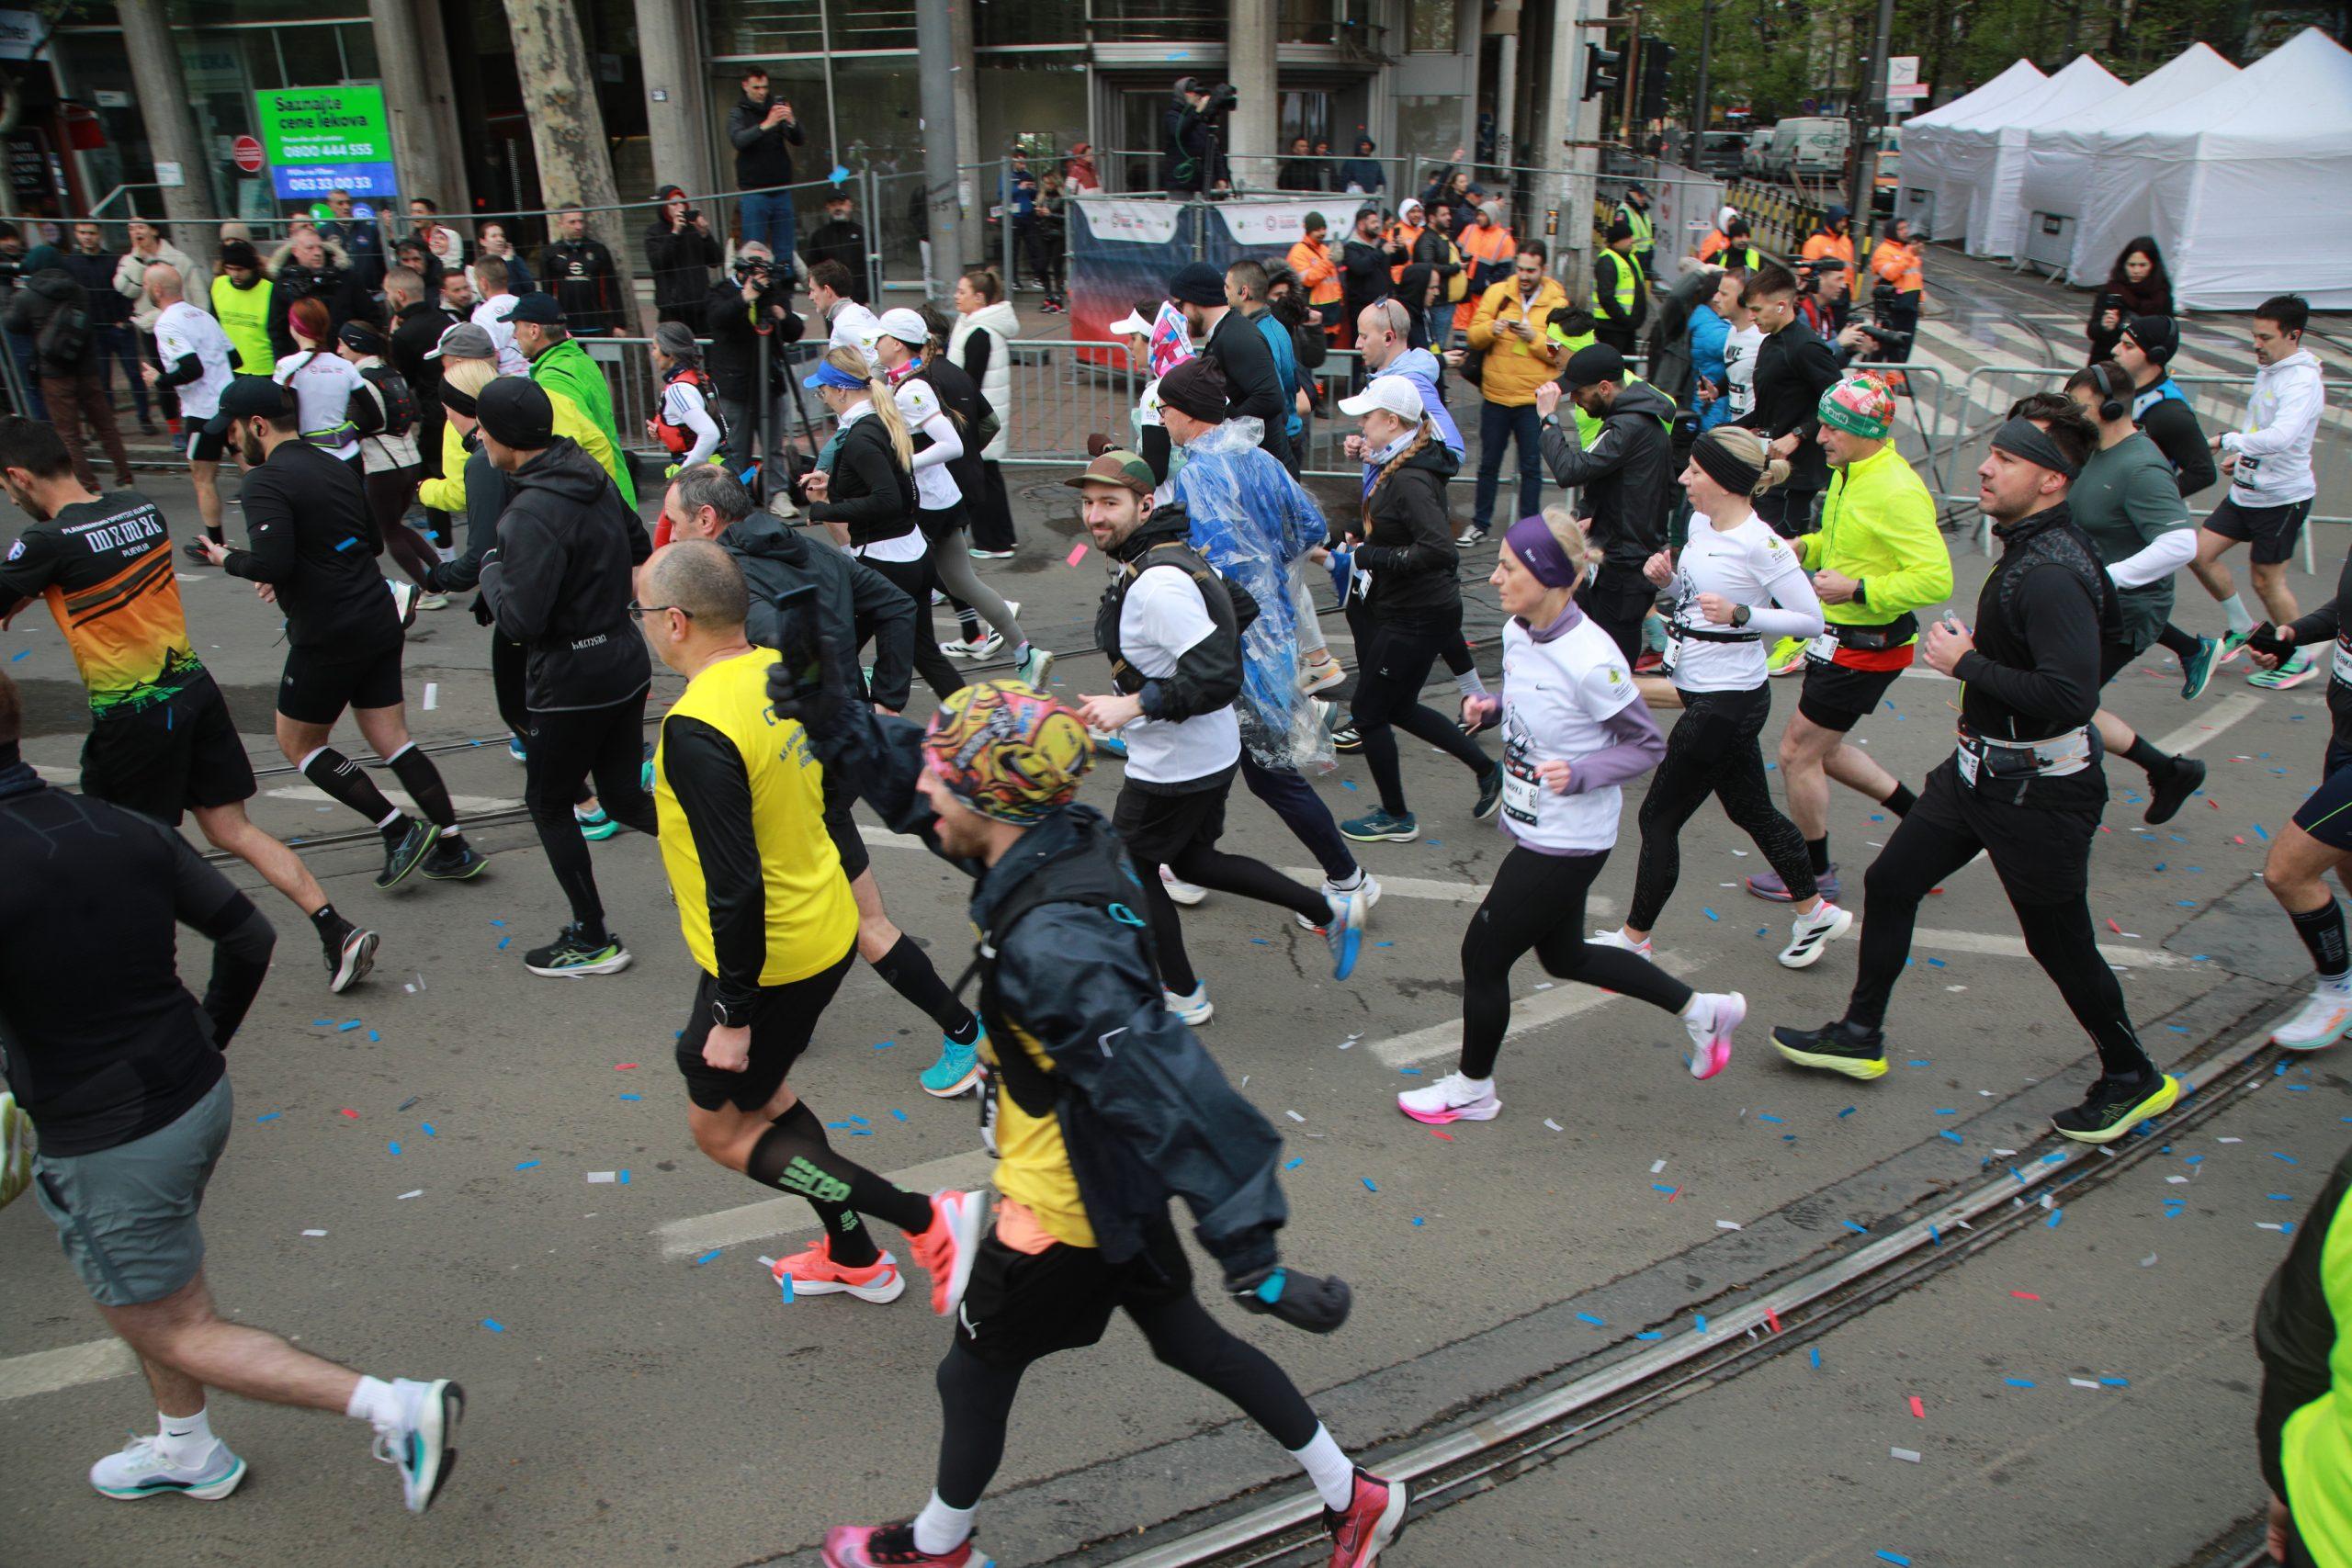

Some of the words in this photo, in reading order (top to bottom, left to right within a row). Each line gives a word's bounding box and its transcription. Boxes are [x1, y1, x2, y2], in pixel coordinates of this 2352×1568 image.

[276, 96, 342, 114] Saznajte
[279, 117, 314, 130] cene
[318, 113, 368, 129] lekova
[322, 144, 347, 156] 444
